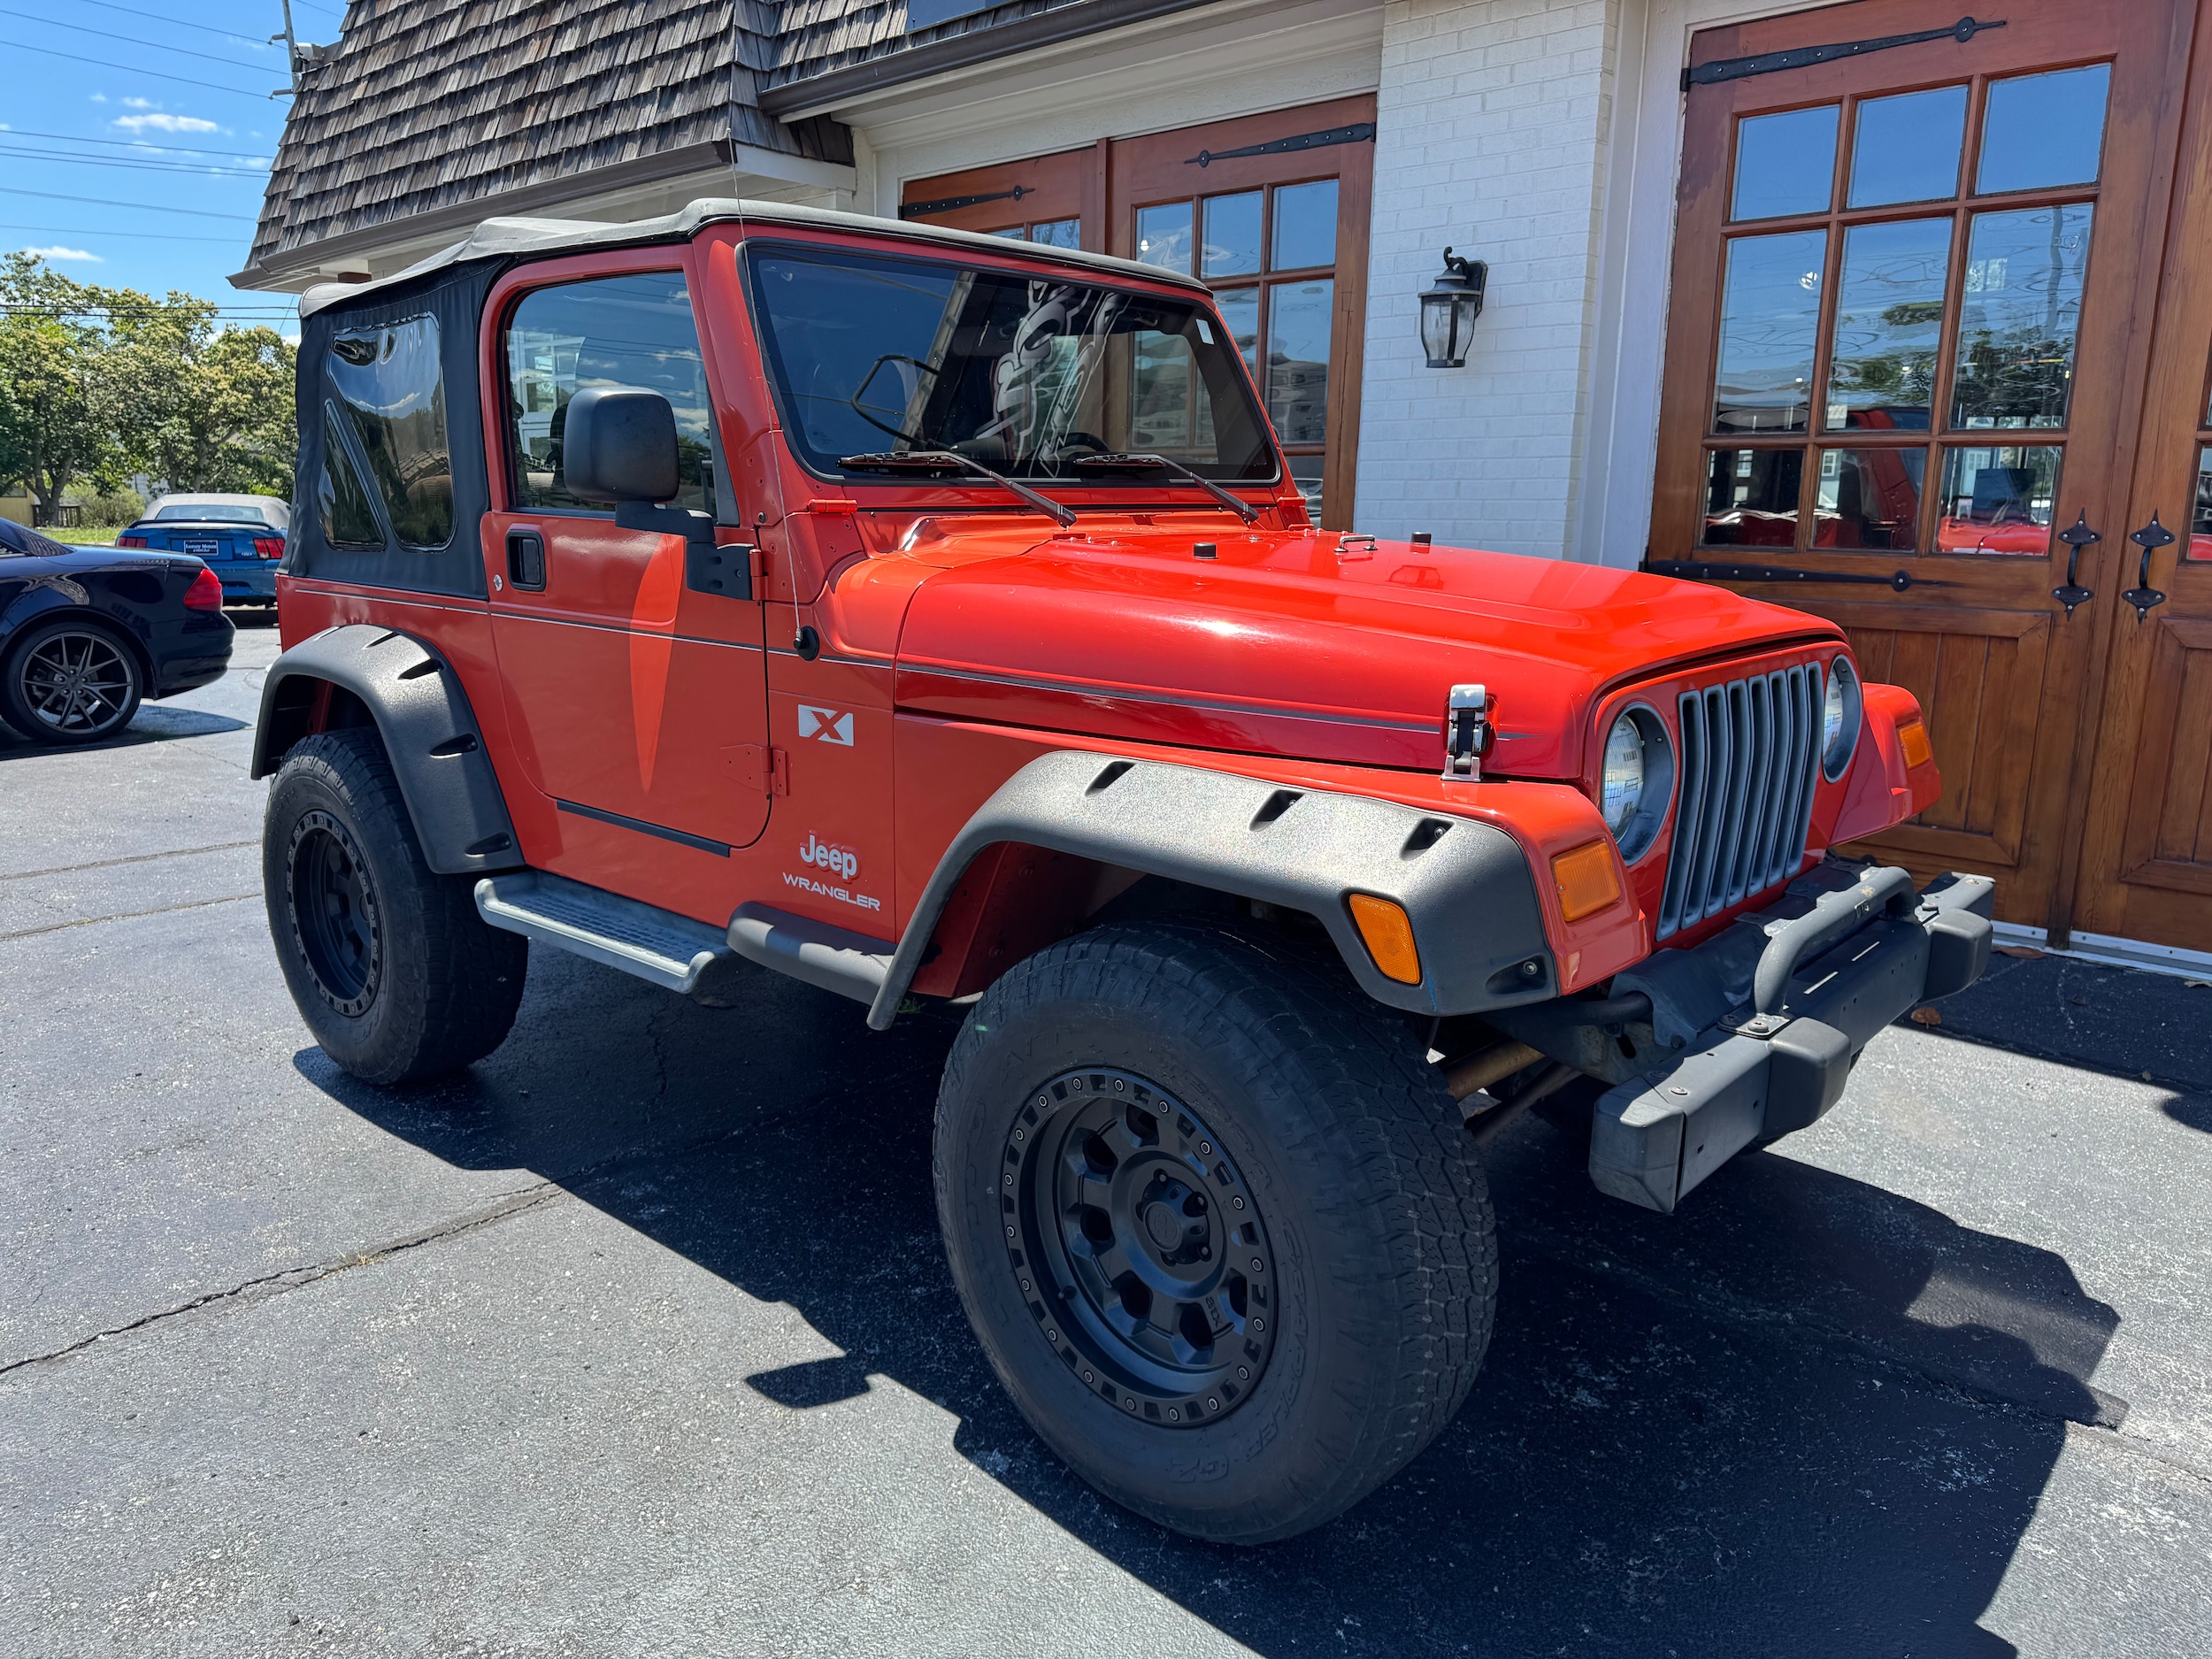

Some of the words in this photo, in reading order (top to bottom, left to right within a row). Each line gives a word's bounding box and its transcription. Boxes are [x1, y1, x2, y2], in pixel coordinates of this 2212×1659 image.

[805, 708, 848, 743] X
[800, 834, 857, 880] Jeep
[782, 872, 881, 912] WRANGLER
